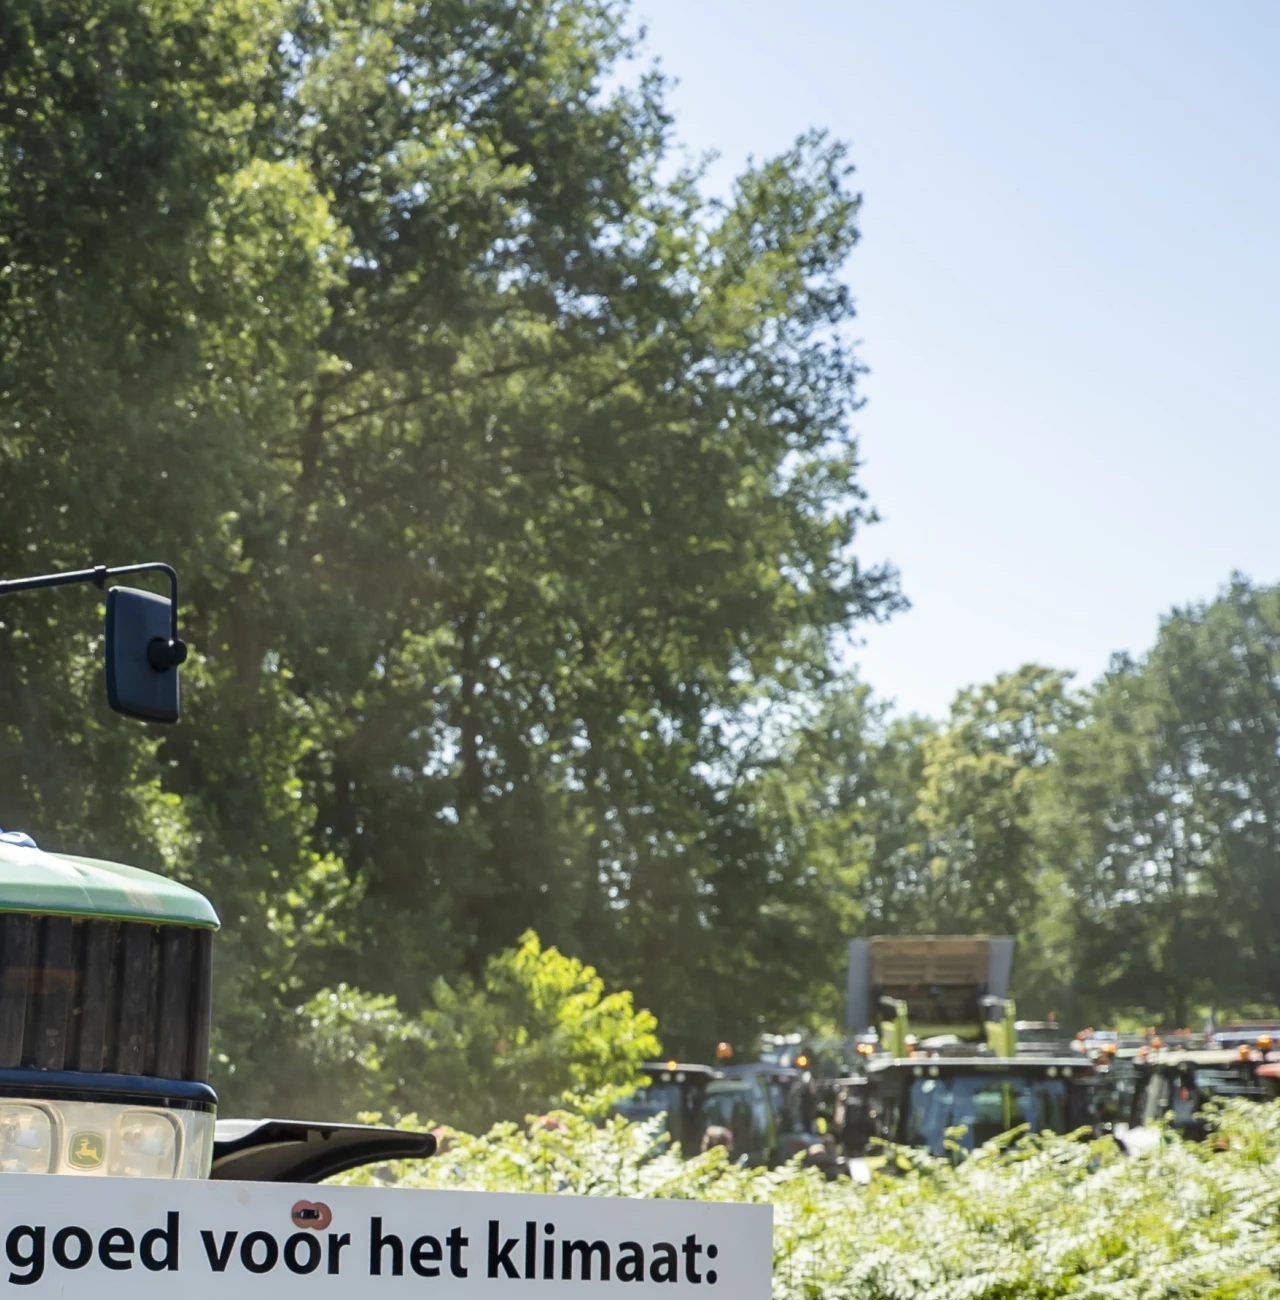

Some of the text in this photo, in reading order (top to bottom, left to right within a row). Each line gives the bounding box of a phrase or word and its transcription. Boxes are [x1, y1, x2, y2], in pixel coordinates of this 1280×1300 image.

[6, 1211, 179, 1285] goed
[200, 1230, 350, 1275] voor
[370, 1217, 468, 1277] het
[488, 1221, 717, 1284] klimaat:
